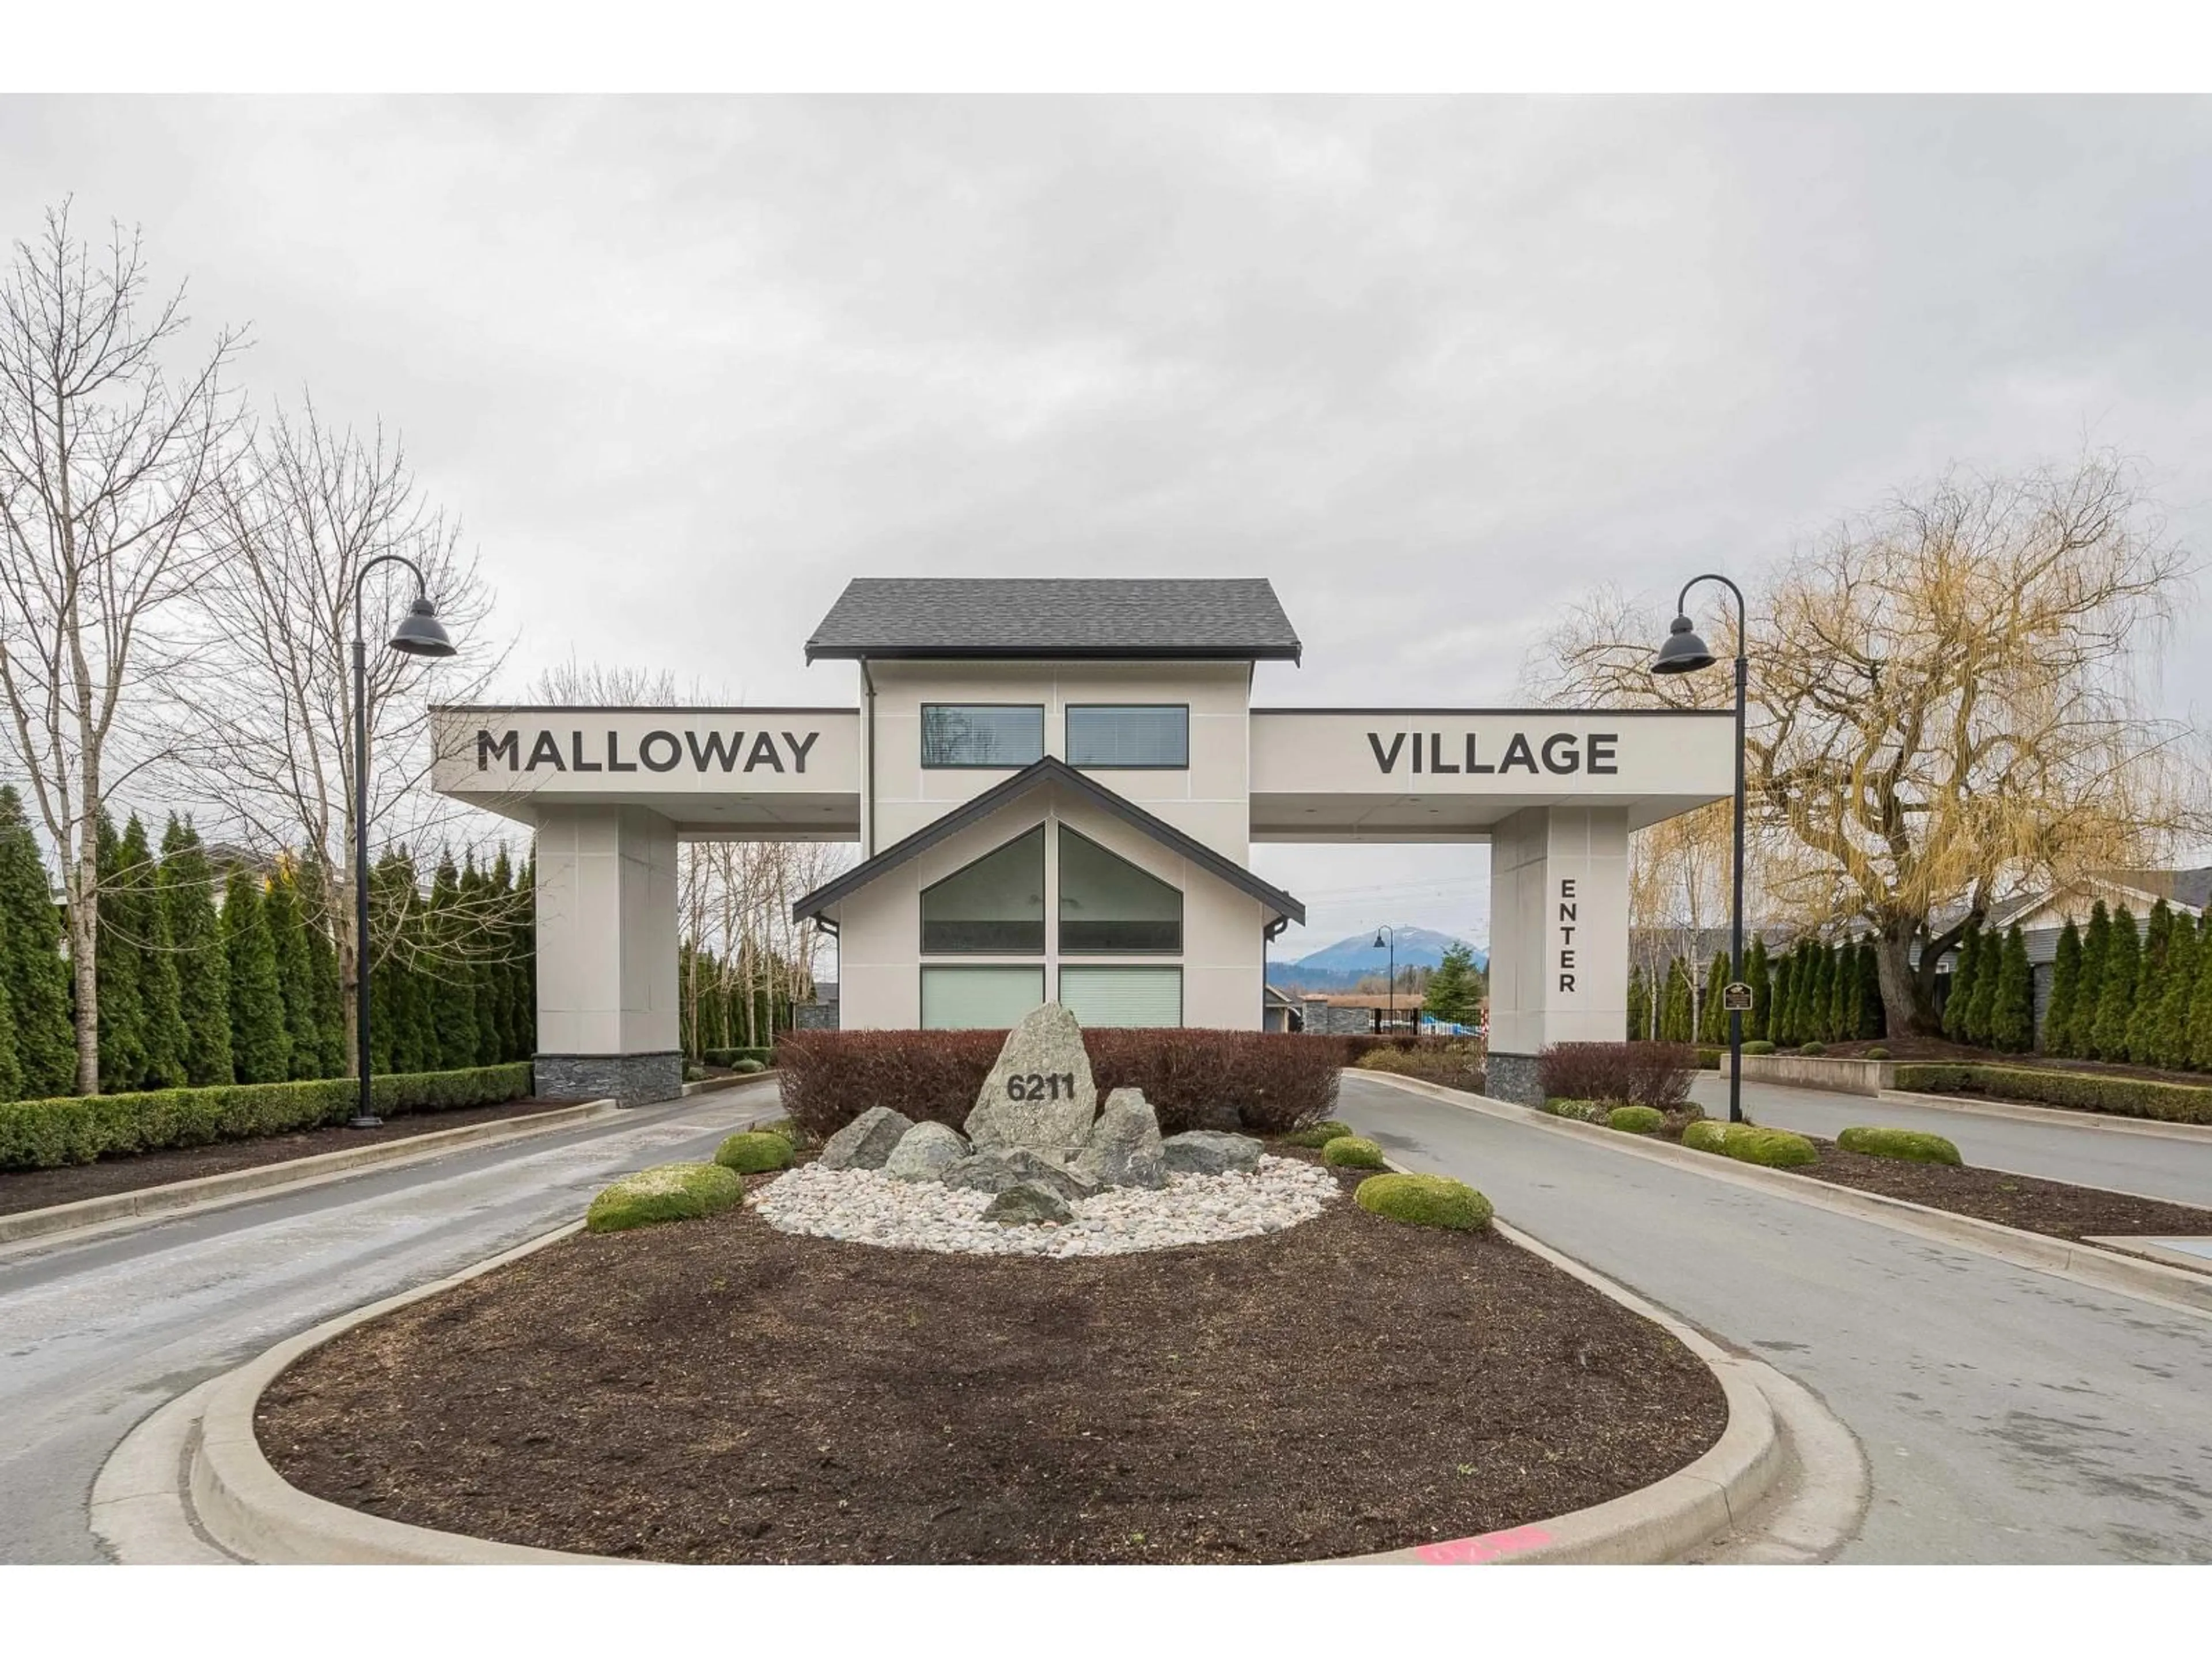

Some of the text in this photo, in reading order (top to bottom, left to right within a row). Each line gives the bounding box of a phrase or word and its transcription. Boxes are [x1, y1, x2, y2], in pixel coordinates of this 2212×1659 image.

[478, 730, 820, 773] MALLOWAY
[1367, 733, 1618, 774] VILLAGE
[1559, 880, 1577, 992] ENTER
[1007, 1072, 1075, 1101] 6211
